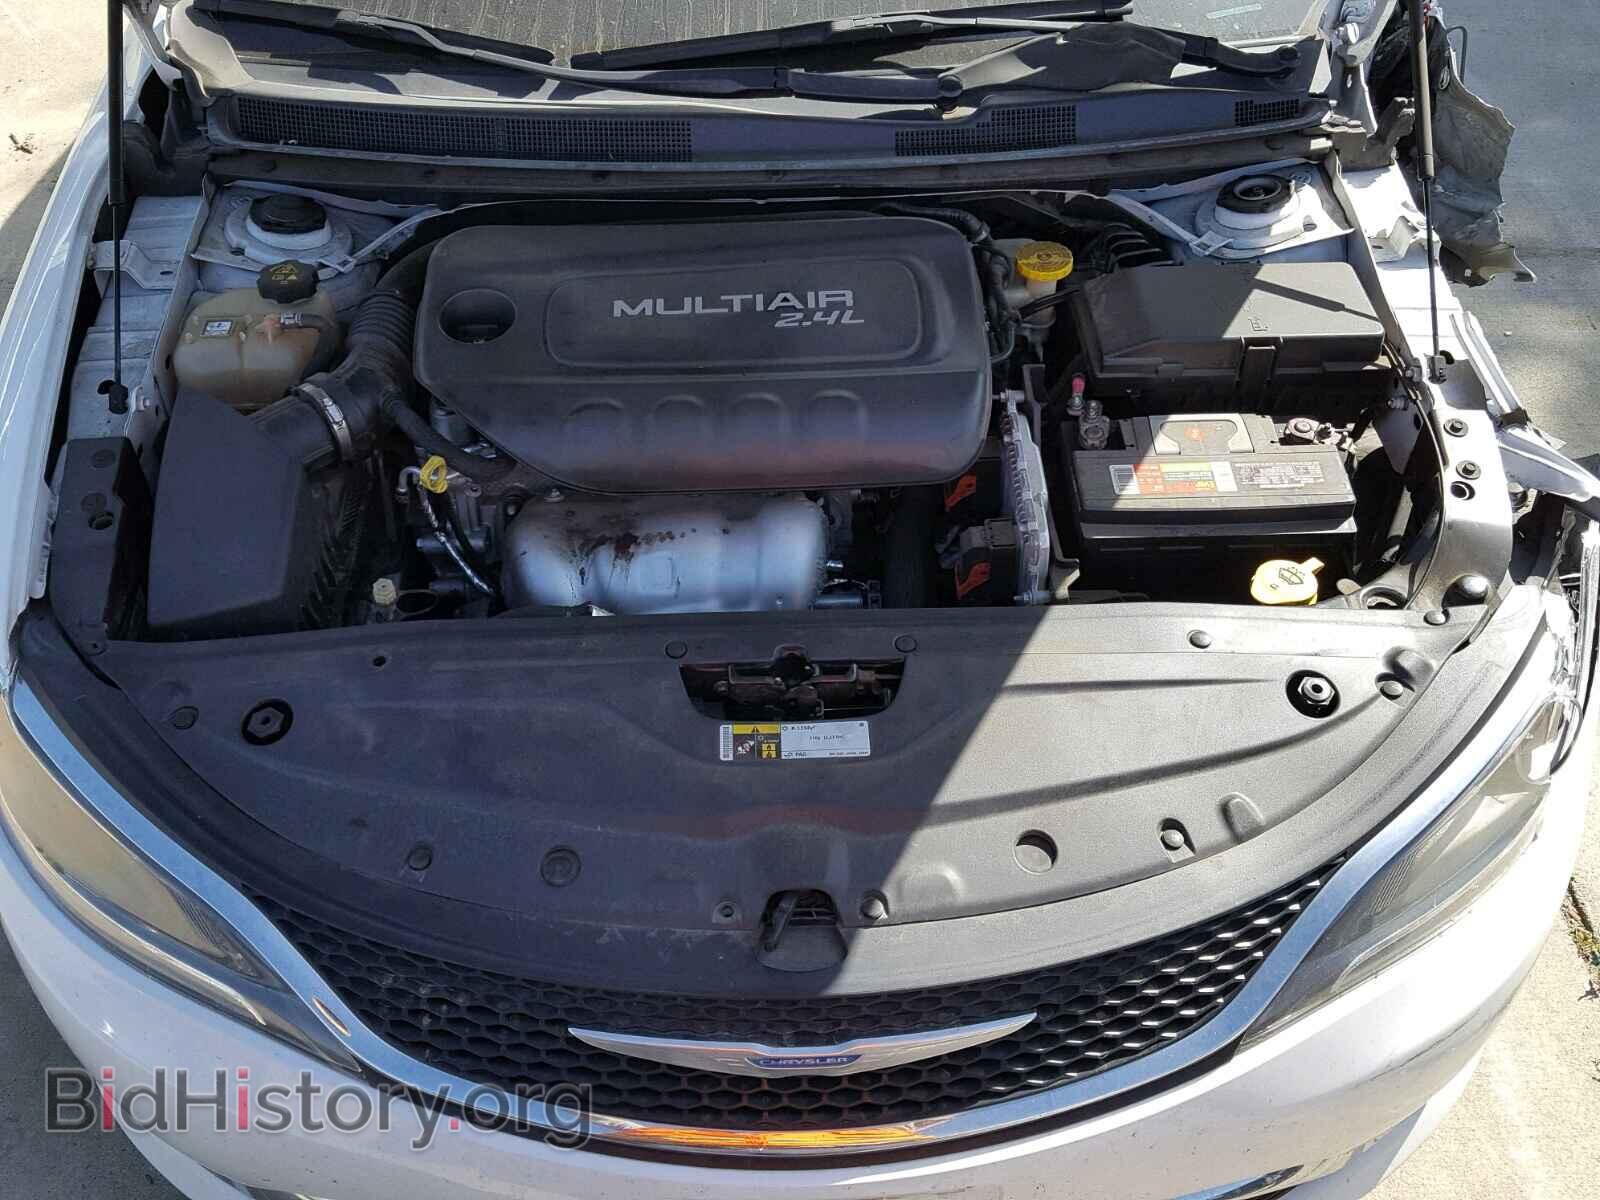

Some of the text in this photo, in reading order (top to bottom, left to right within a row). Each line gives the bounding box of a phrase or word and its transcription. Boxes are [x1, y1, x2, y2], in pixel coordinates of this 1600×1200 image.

[612, 289, 854, 318] MULTIAIR
[774, 309, 865, 328] 2.4L
[759, 1056, 849, 1066] CHRYSLER
